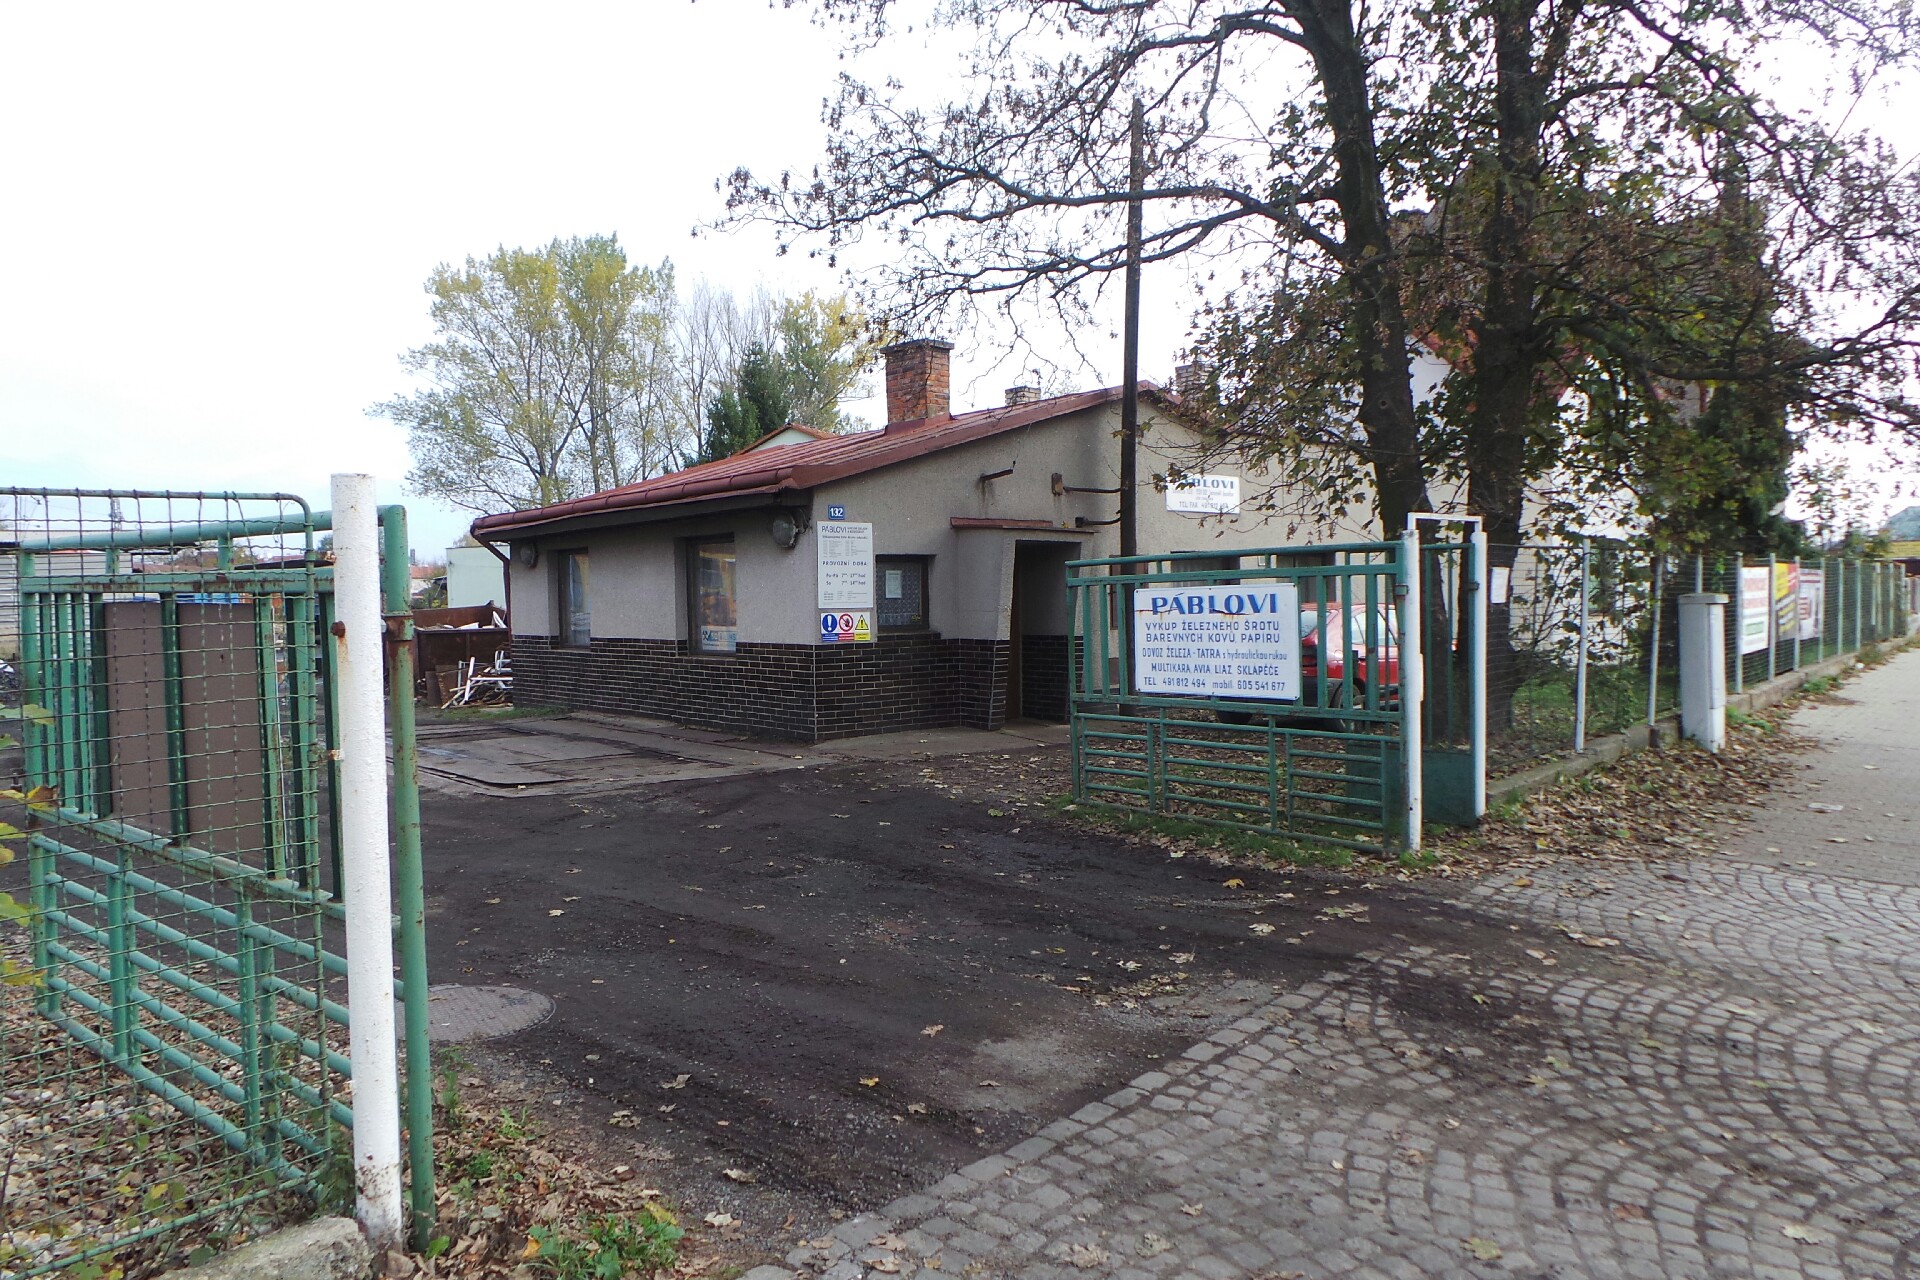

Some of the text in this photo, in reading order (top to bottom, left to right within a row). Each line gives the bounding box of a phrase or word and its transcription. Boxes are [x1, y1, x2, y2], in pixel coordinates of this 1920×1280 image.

[1181, 478, 1234, 489] BLOVI
[830, 508, 843, 517] 132
[1151, 592, 1278, 615] PÁBLOVI
[1142, 648, 1163, 658] ODVOZ
[1166, 646, 1191, 658] ŽELEZA
[1197, 648, 1221, 659] TATRA
[1227, 649, 1268, 662] hydraulickou
[1269, 650, 1288, 661] rukou
[1191, 678, 1206, 688] 494
[1237, 680, 1253, 690] 605
[1255, 681, 1269, 691] 541
